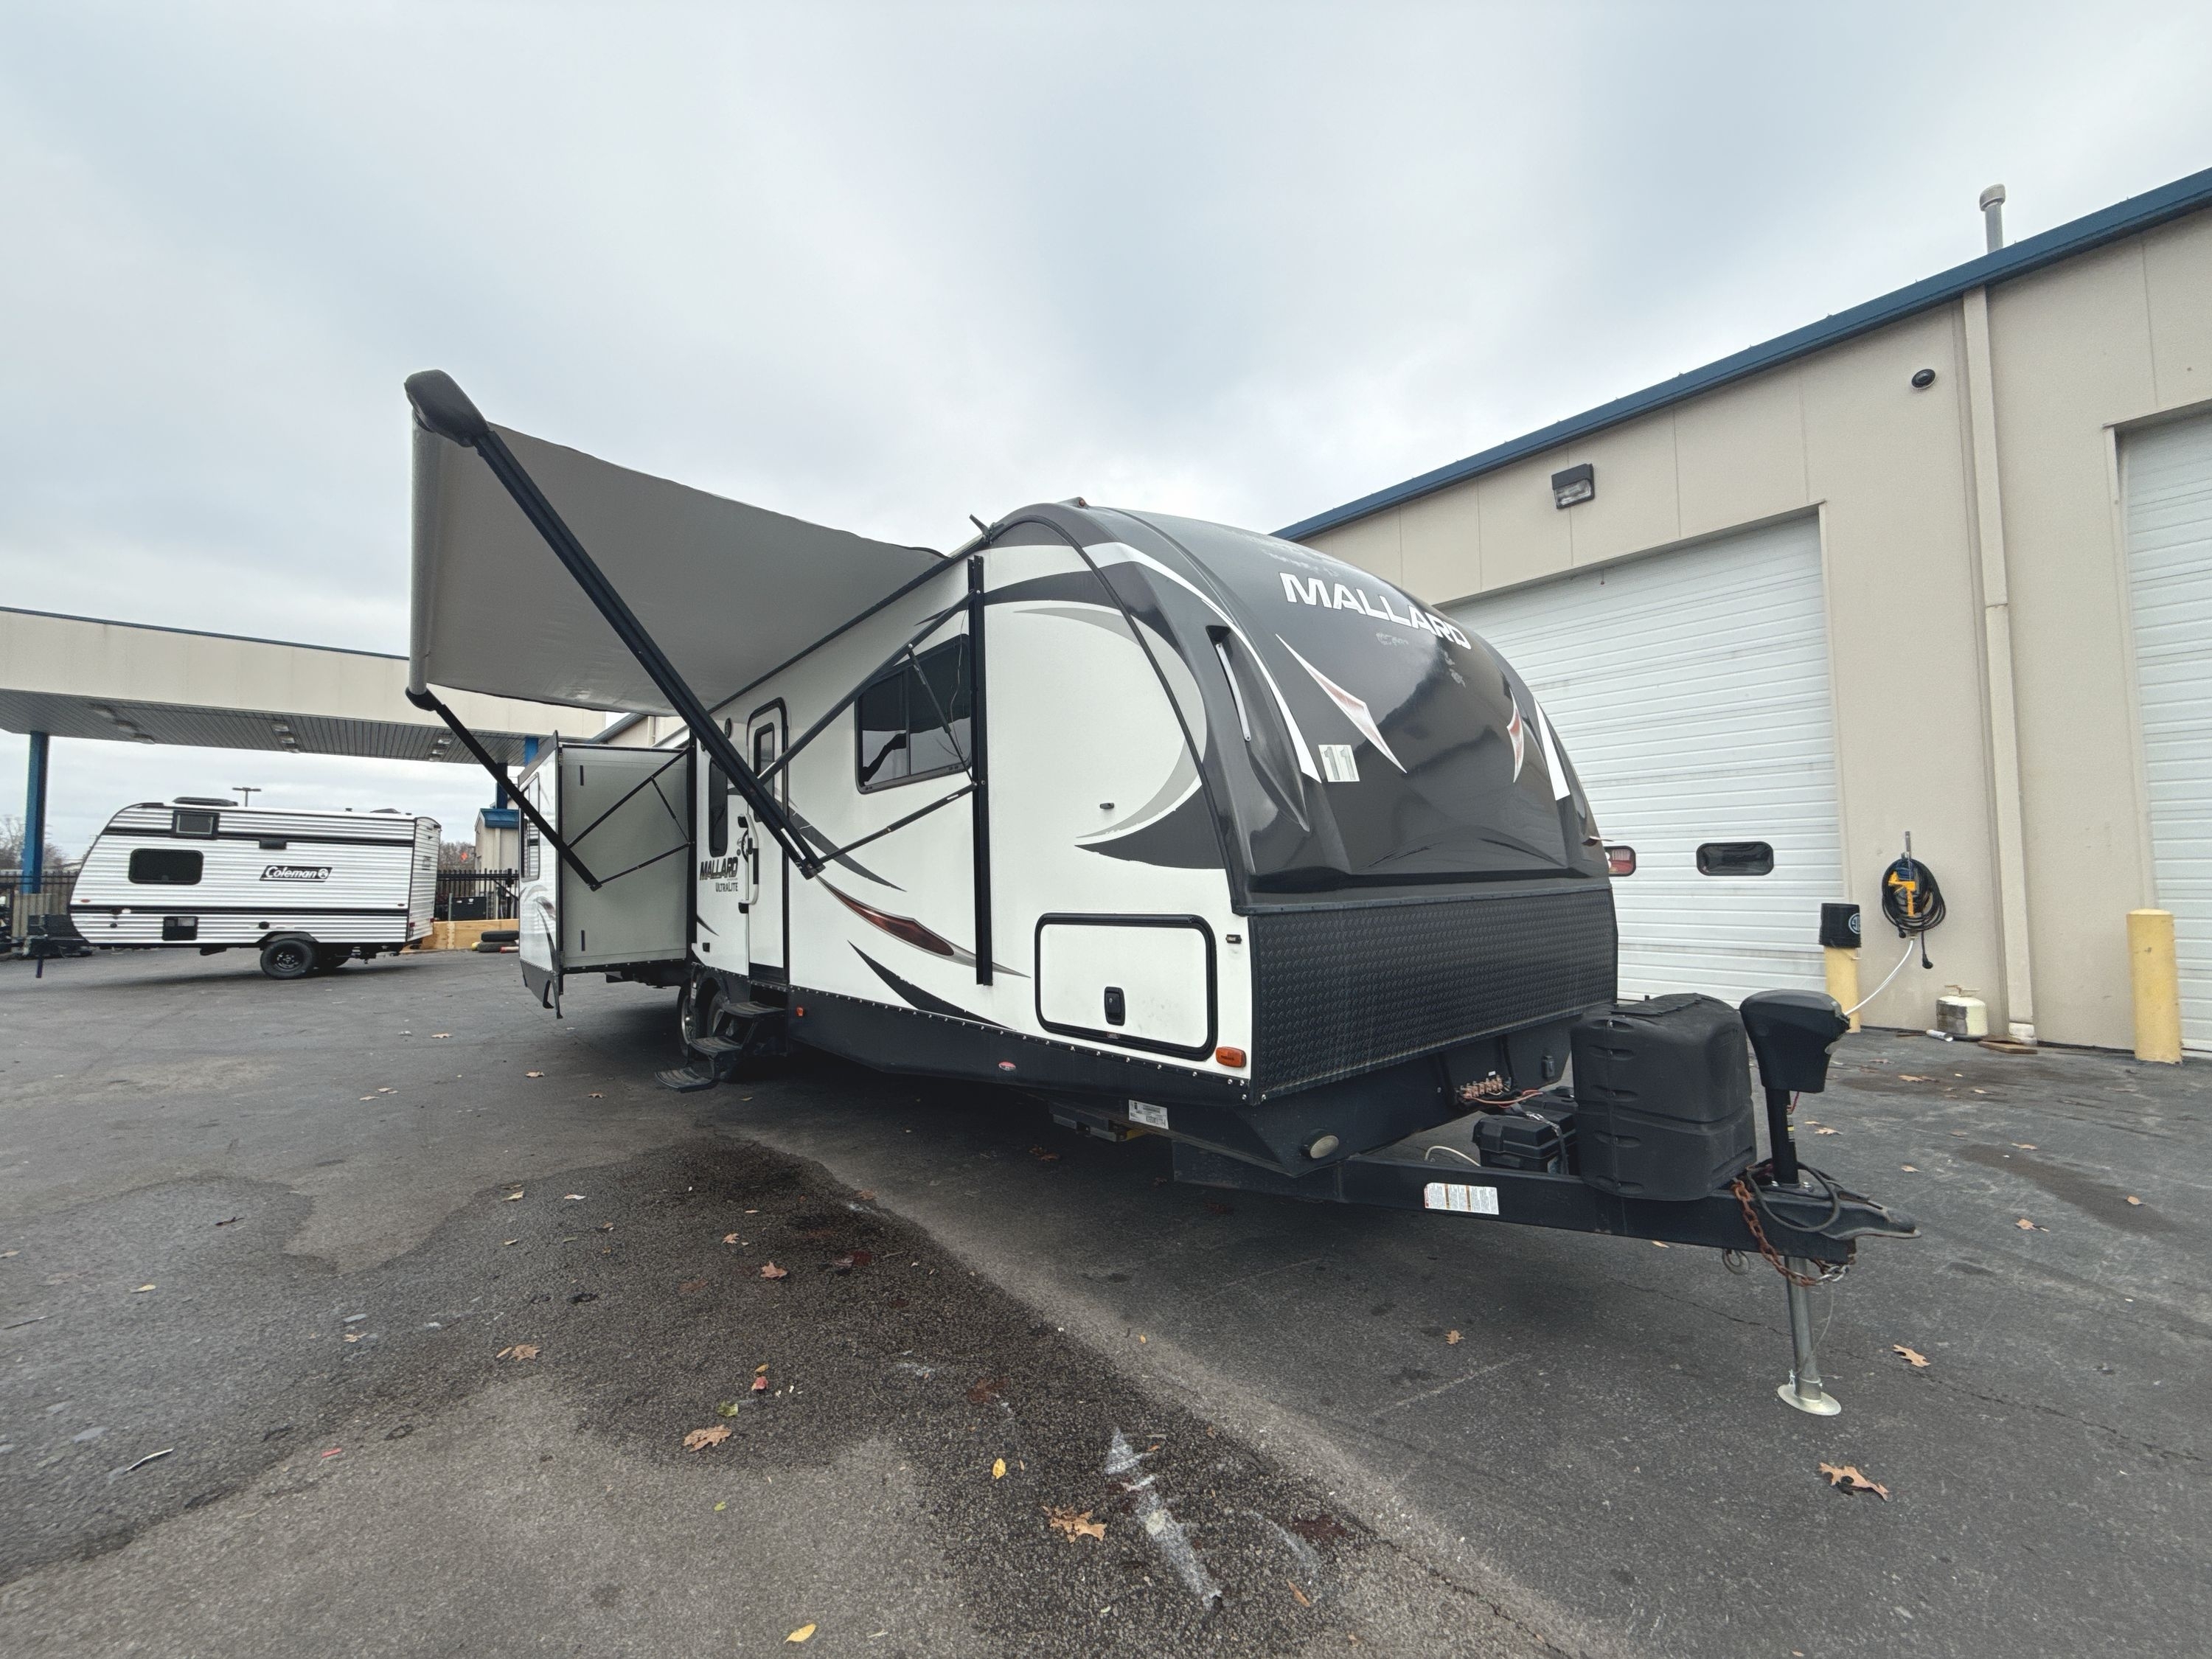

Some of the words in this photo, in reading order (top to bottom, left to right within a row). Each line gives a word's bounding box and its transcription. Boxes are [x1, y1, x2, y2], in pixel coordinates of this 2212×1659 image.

[1279, 572, 1472, 650] MALLARD
[1324, 746, 1357, 781] 11
[265, 866, 318, 879] Coleman
[699, 856, 739, 881] MALLARD
